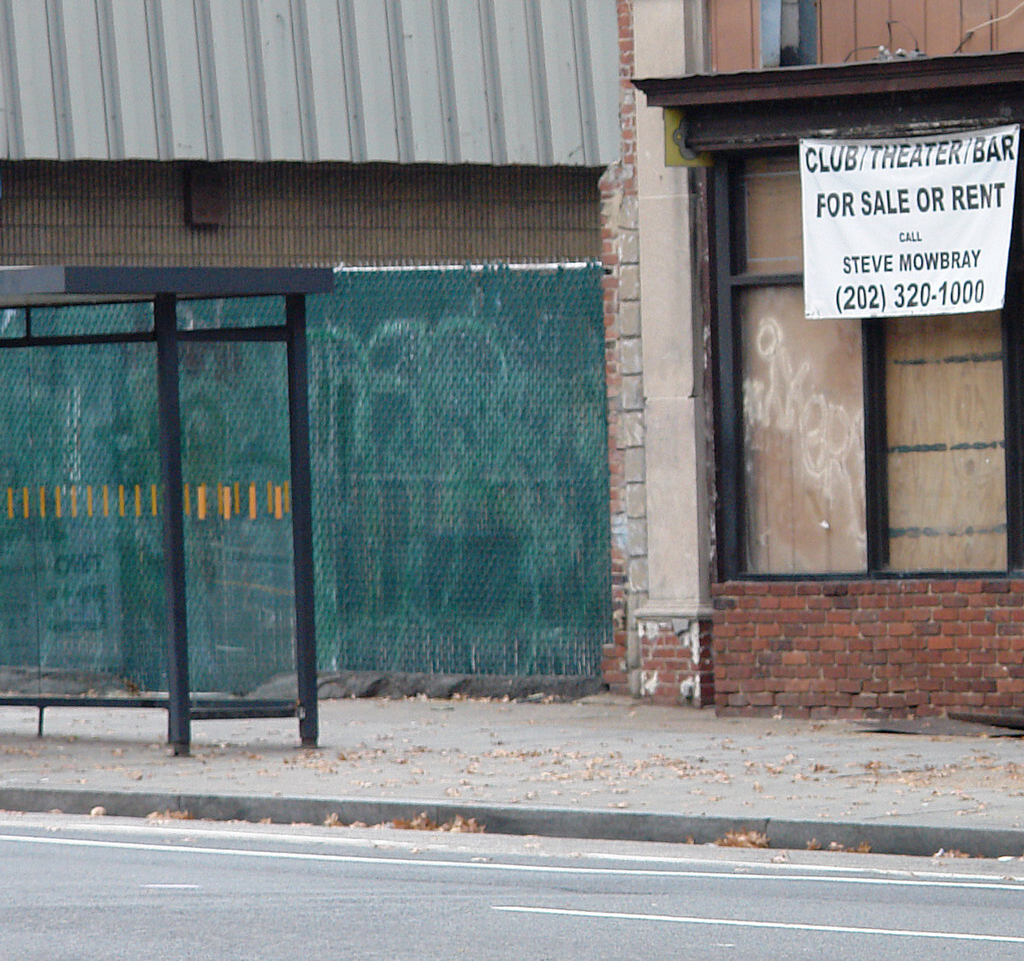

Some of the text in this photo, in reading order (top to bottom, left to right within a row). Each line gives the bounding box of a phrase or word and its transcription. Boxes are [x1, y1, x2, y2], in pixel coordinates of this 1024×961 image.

[805, 134, 1015, 173] CLUB/THEATER/BAR
[816, 182, 1006, 218] FOR SALE OR RENT
[898, 231, 922, 243] CALL
[843, 249, 982, 275] STEVE MOWBRAY
[835, 279, 985, 314] (202) 320-1000
